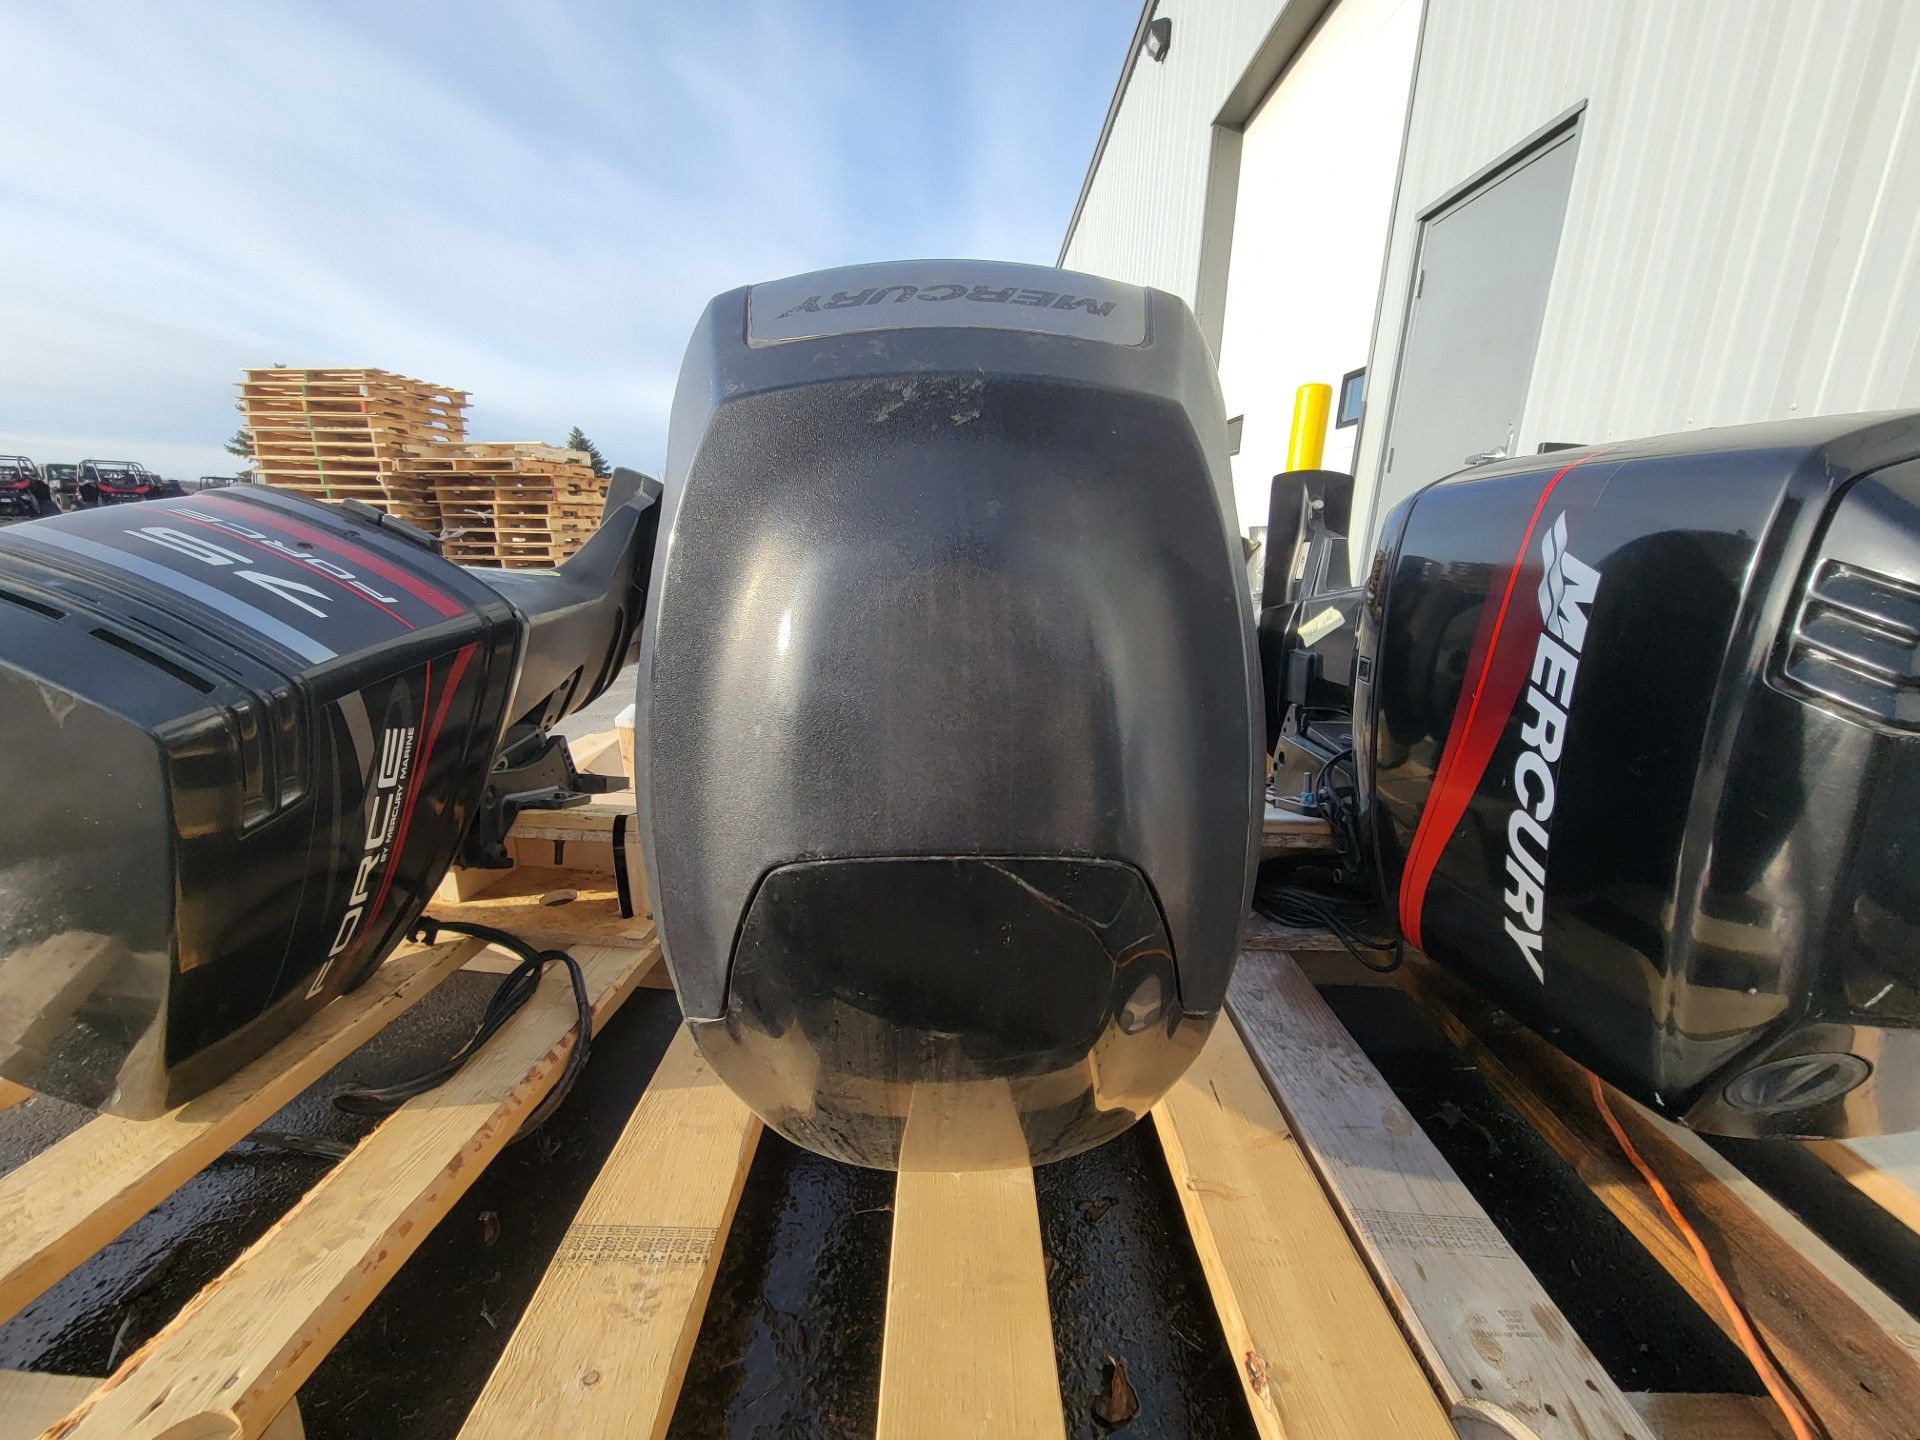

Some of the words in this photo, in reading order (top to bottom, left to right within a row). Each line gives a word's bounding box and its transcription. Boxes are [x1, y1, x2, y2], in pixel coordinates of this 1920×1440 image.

[773, 284, 1118, 320] MERCURY
[123, 526, 334, 618] 75
[168, 508, 399, 603] FORCE
[380, 848, 389, 863] BY
[386, 785, 404, 844] MERCURY
[399, 727, 415, 780] MARINE
[1503, 549, 1602, 984] MERCURY
[305, 728, 406, 1000] FORCE
